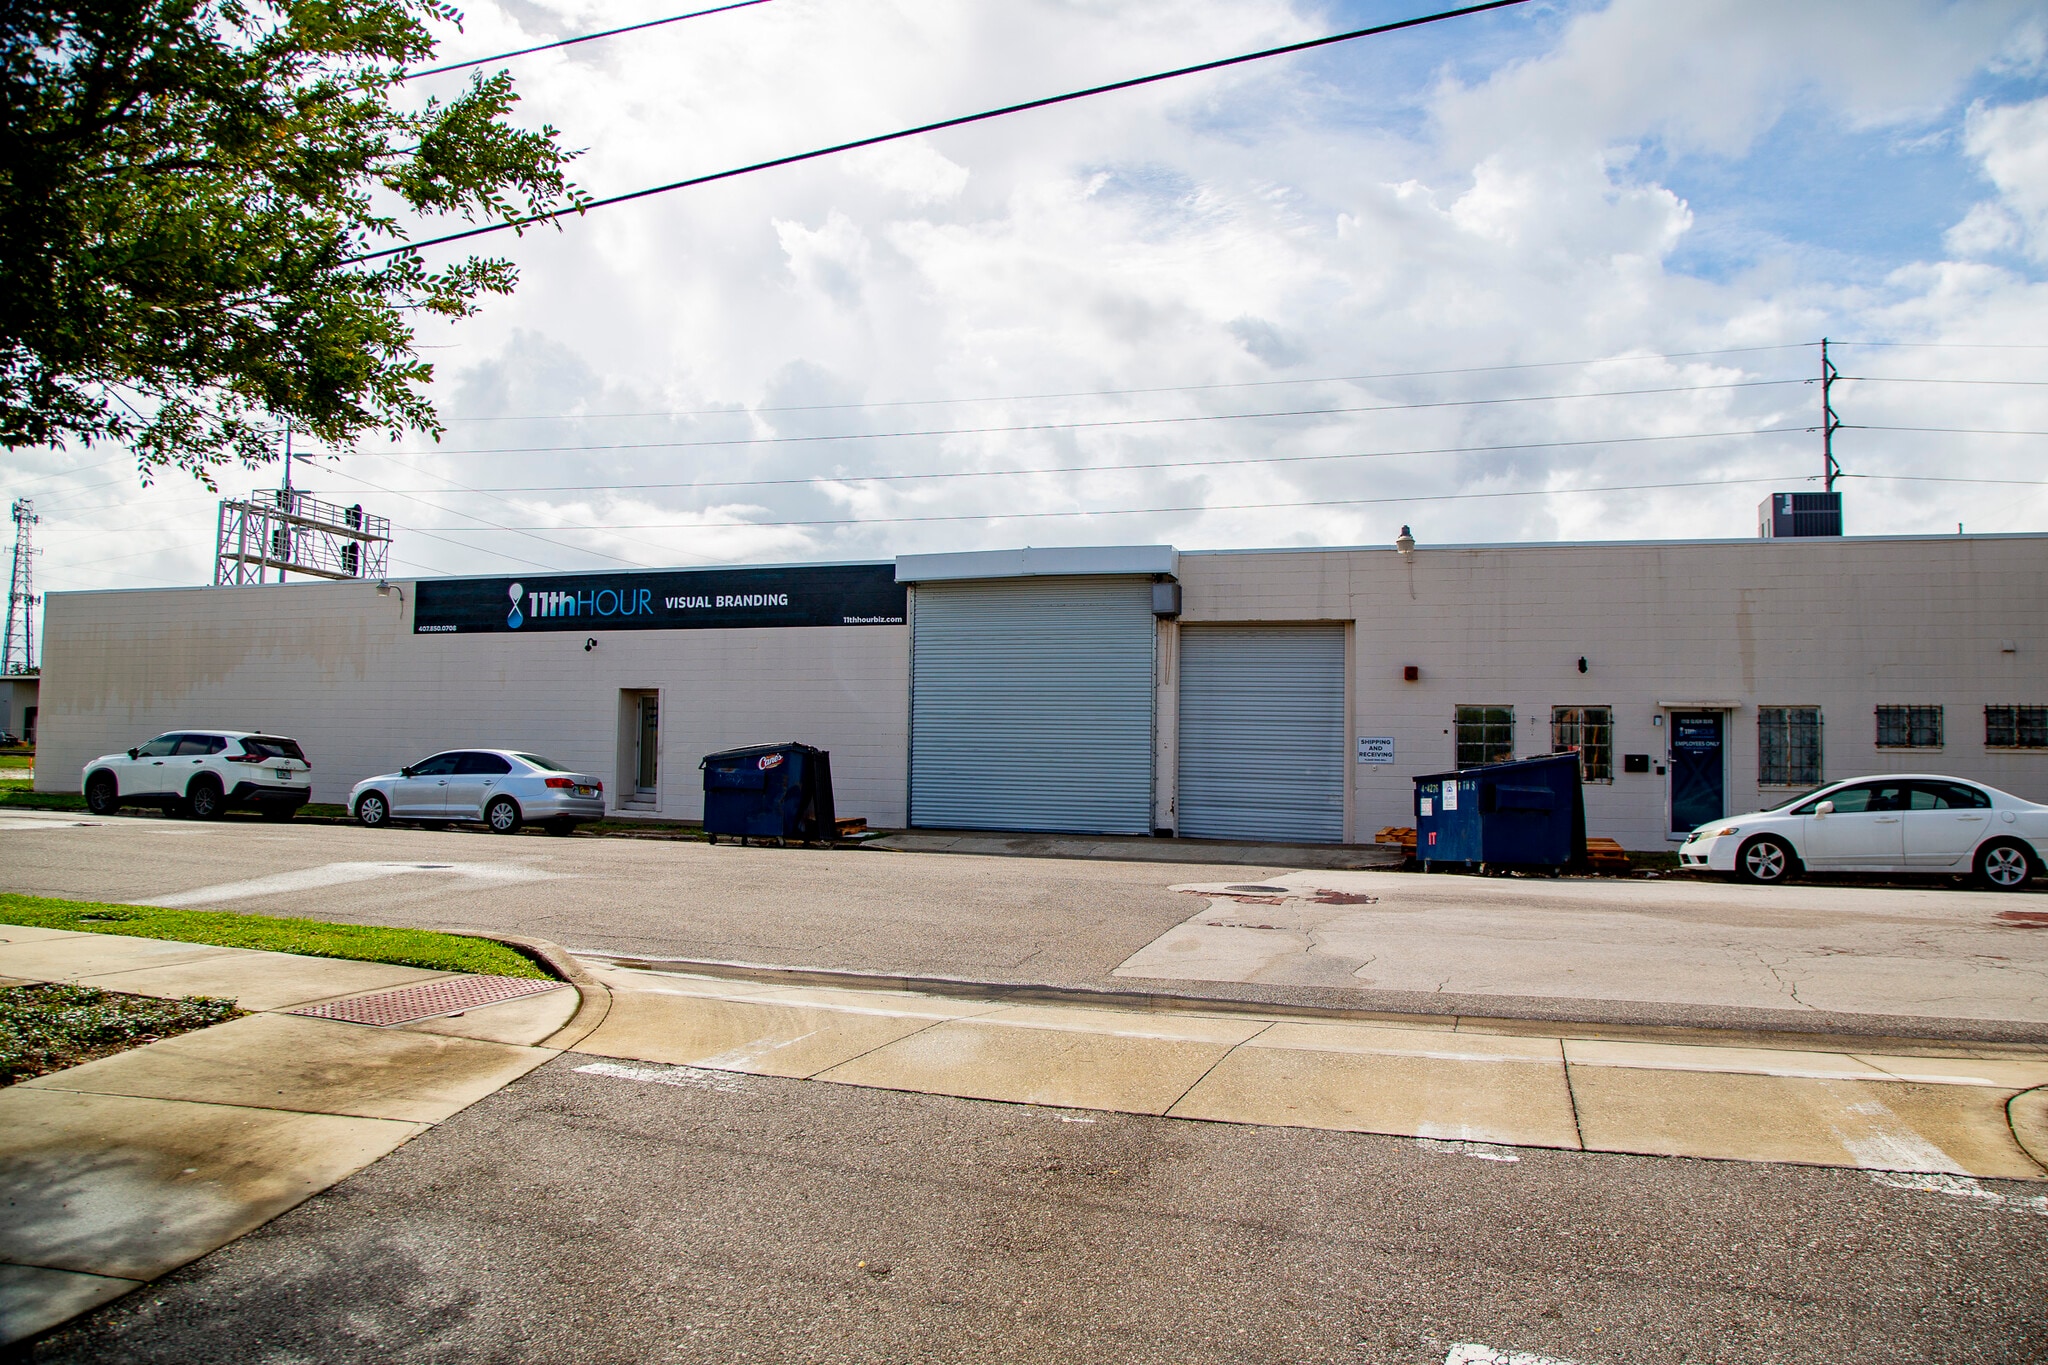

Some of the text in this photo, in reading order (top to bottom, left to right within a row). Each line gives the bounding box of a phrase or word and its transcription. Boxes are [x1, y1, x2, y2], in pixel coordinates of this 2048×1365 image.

[665, 593, 789, 609] VISUAL BRANDING
[843, 616, 903, 624] 11thhourbiz.com
[758, 752, 784, 770] Cane's
